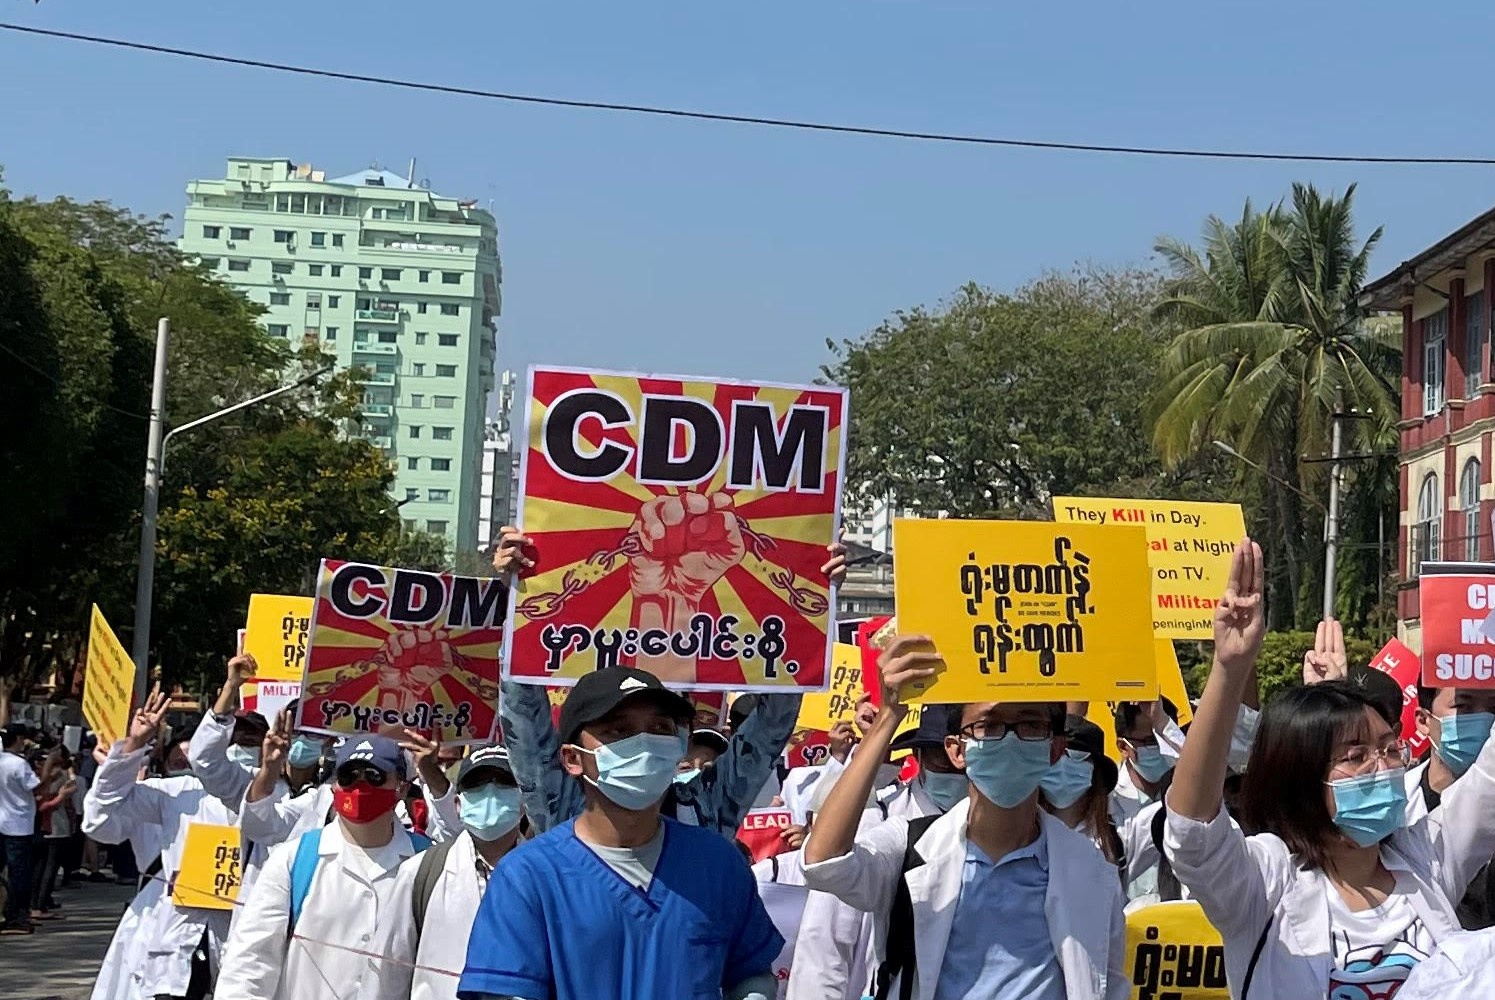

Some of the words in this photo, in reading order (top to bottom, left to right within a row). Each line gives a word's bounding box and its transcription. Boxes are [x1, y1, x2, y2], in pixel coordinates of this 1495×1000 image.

[546, 391, 830, 490] CDM
[1065, 507, 1107, 525] They
[1112, 508, 1145, 523] Kill
[1150, 510, 1165, 523] in
[1171, 511, 1207, 527] Day.
[1173, 540, 1188, 551] at
[1157, 568, 1178, 580] on
[1182, 567, 1210, 581] TV.
[332, 565, 508, 627] CDM
[1158, 594, 1220, 609] Militar
[262, 685, 300, 696] MILIT
[743, 814, 790, 830] LEAD
